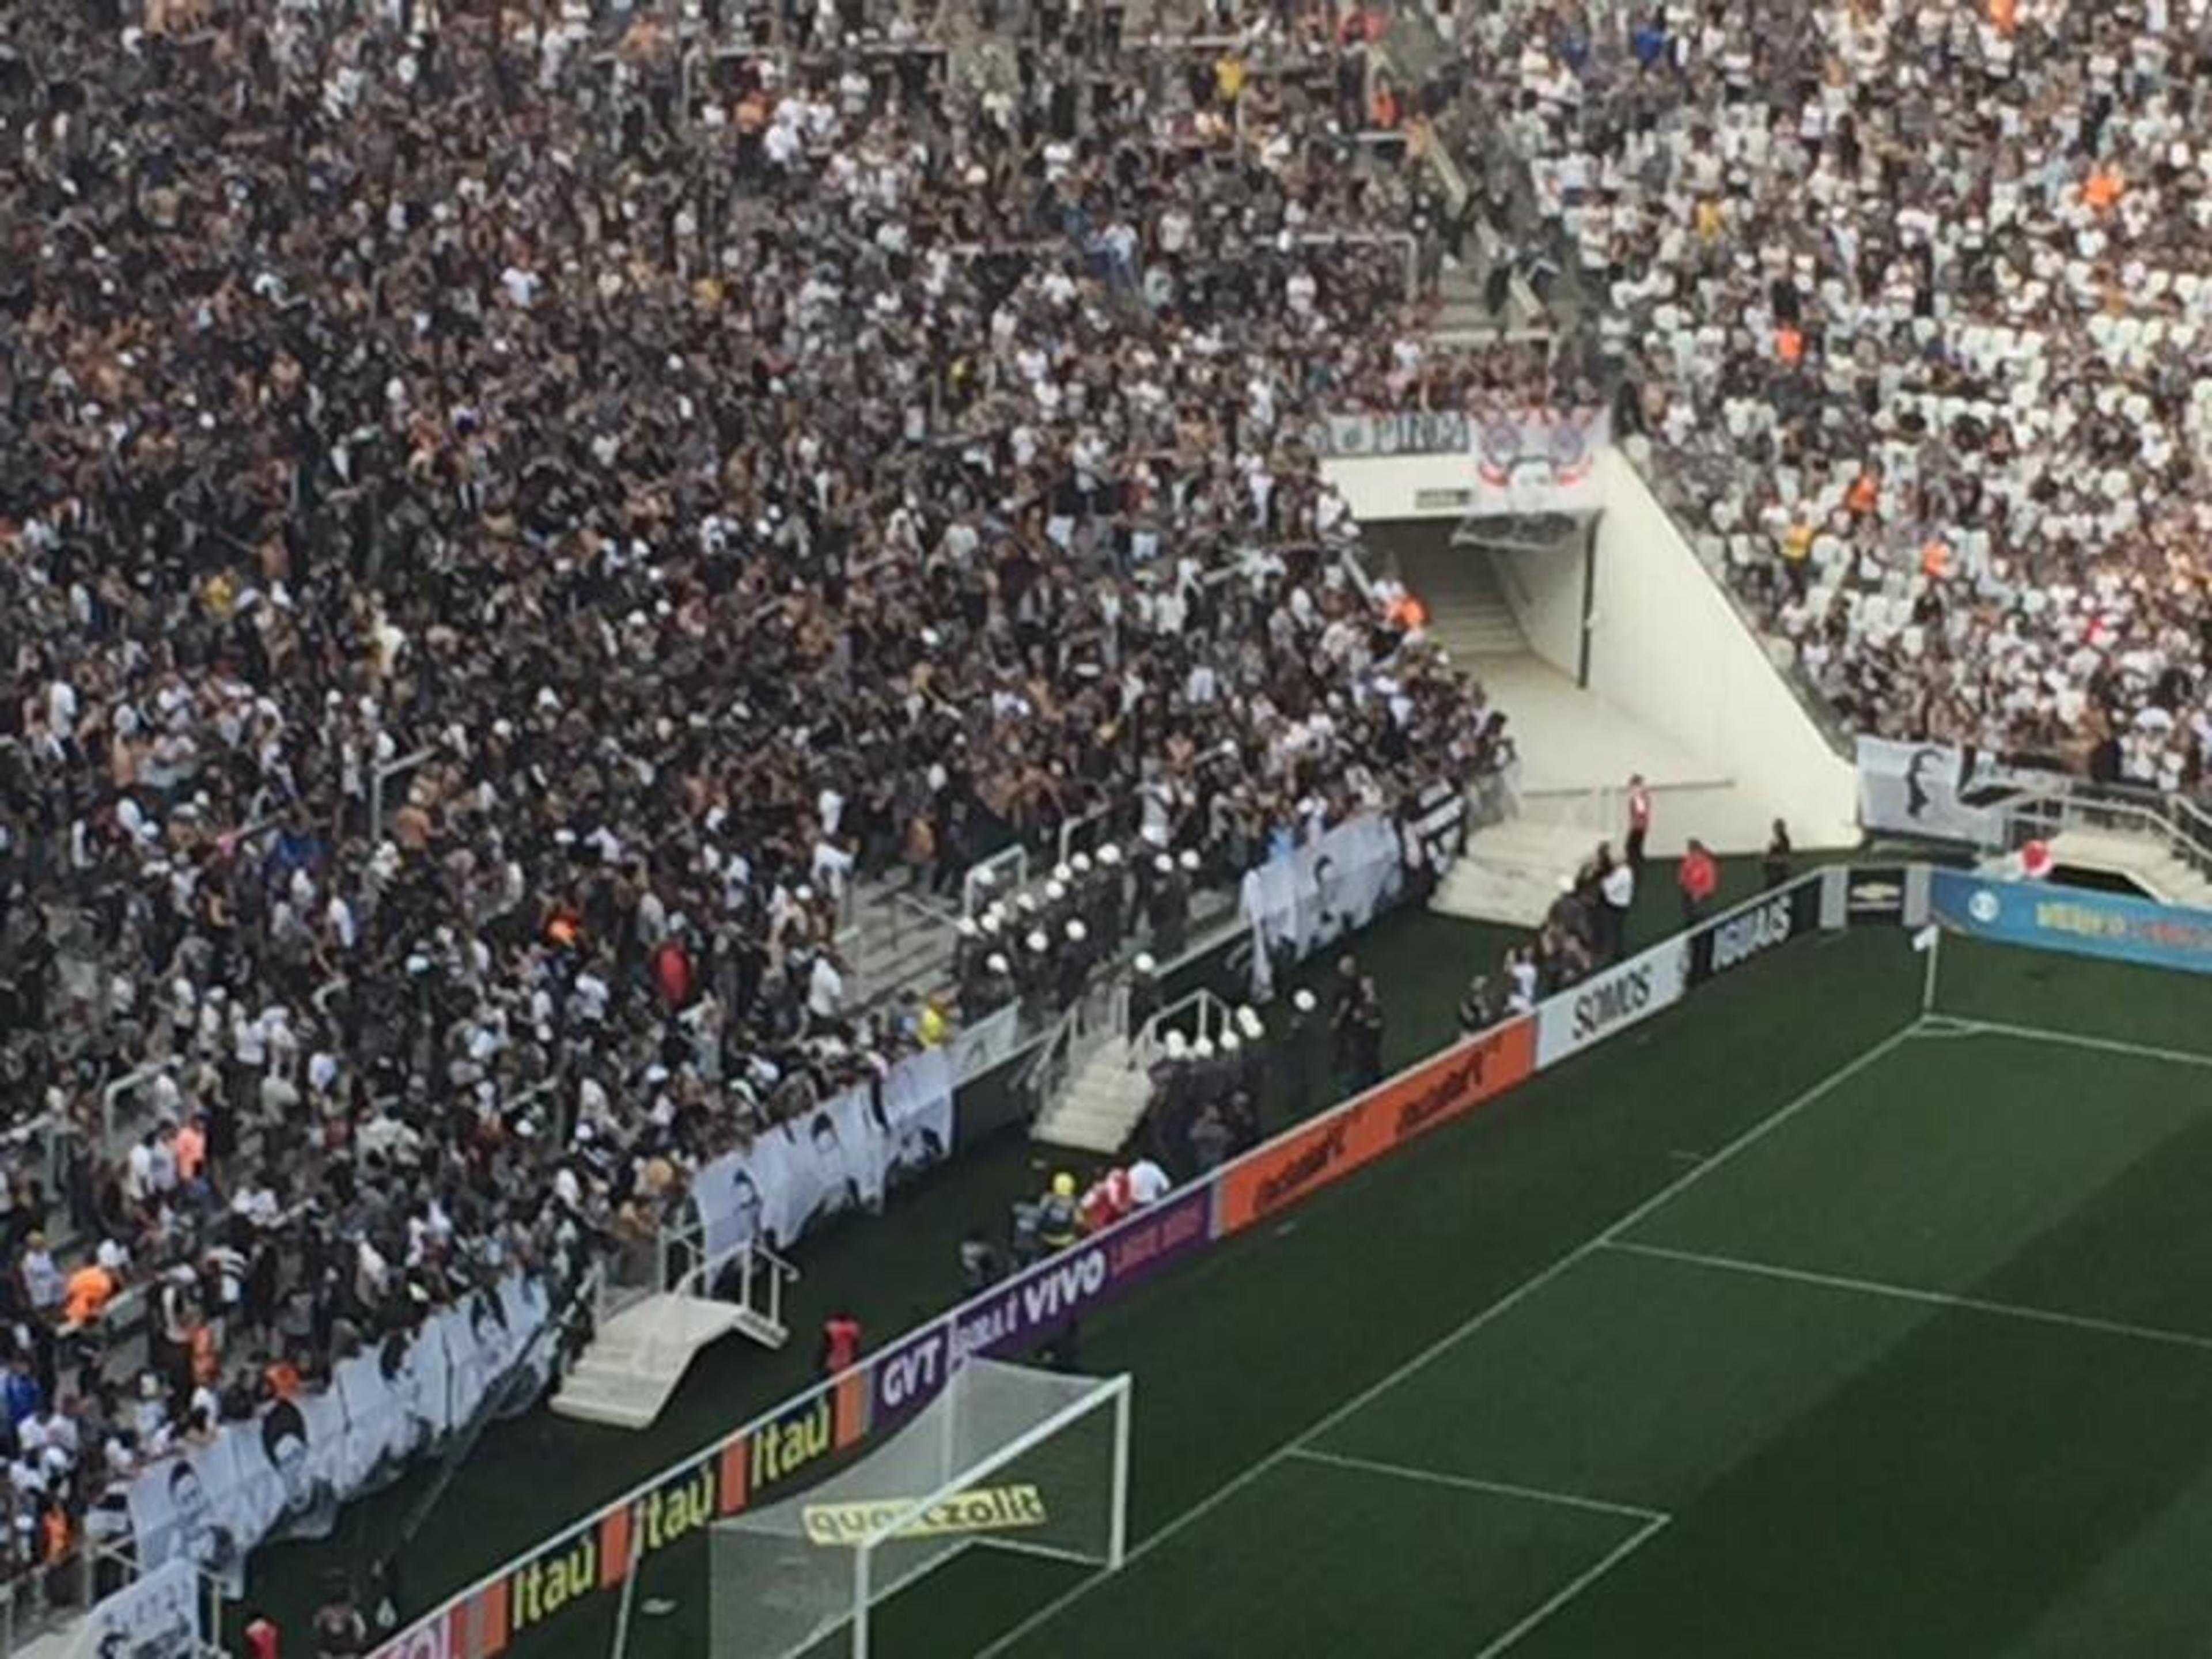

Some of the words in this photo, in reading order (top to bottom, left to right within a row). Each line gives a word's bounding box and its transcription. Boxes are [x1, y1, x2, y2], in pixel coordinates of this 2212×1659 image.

[882, 1339, 941, 1406] GVT
[1025, 1251, 1105, 1322] VIVO
[512, 1538, 594, 1628] Itaú
